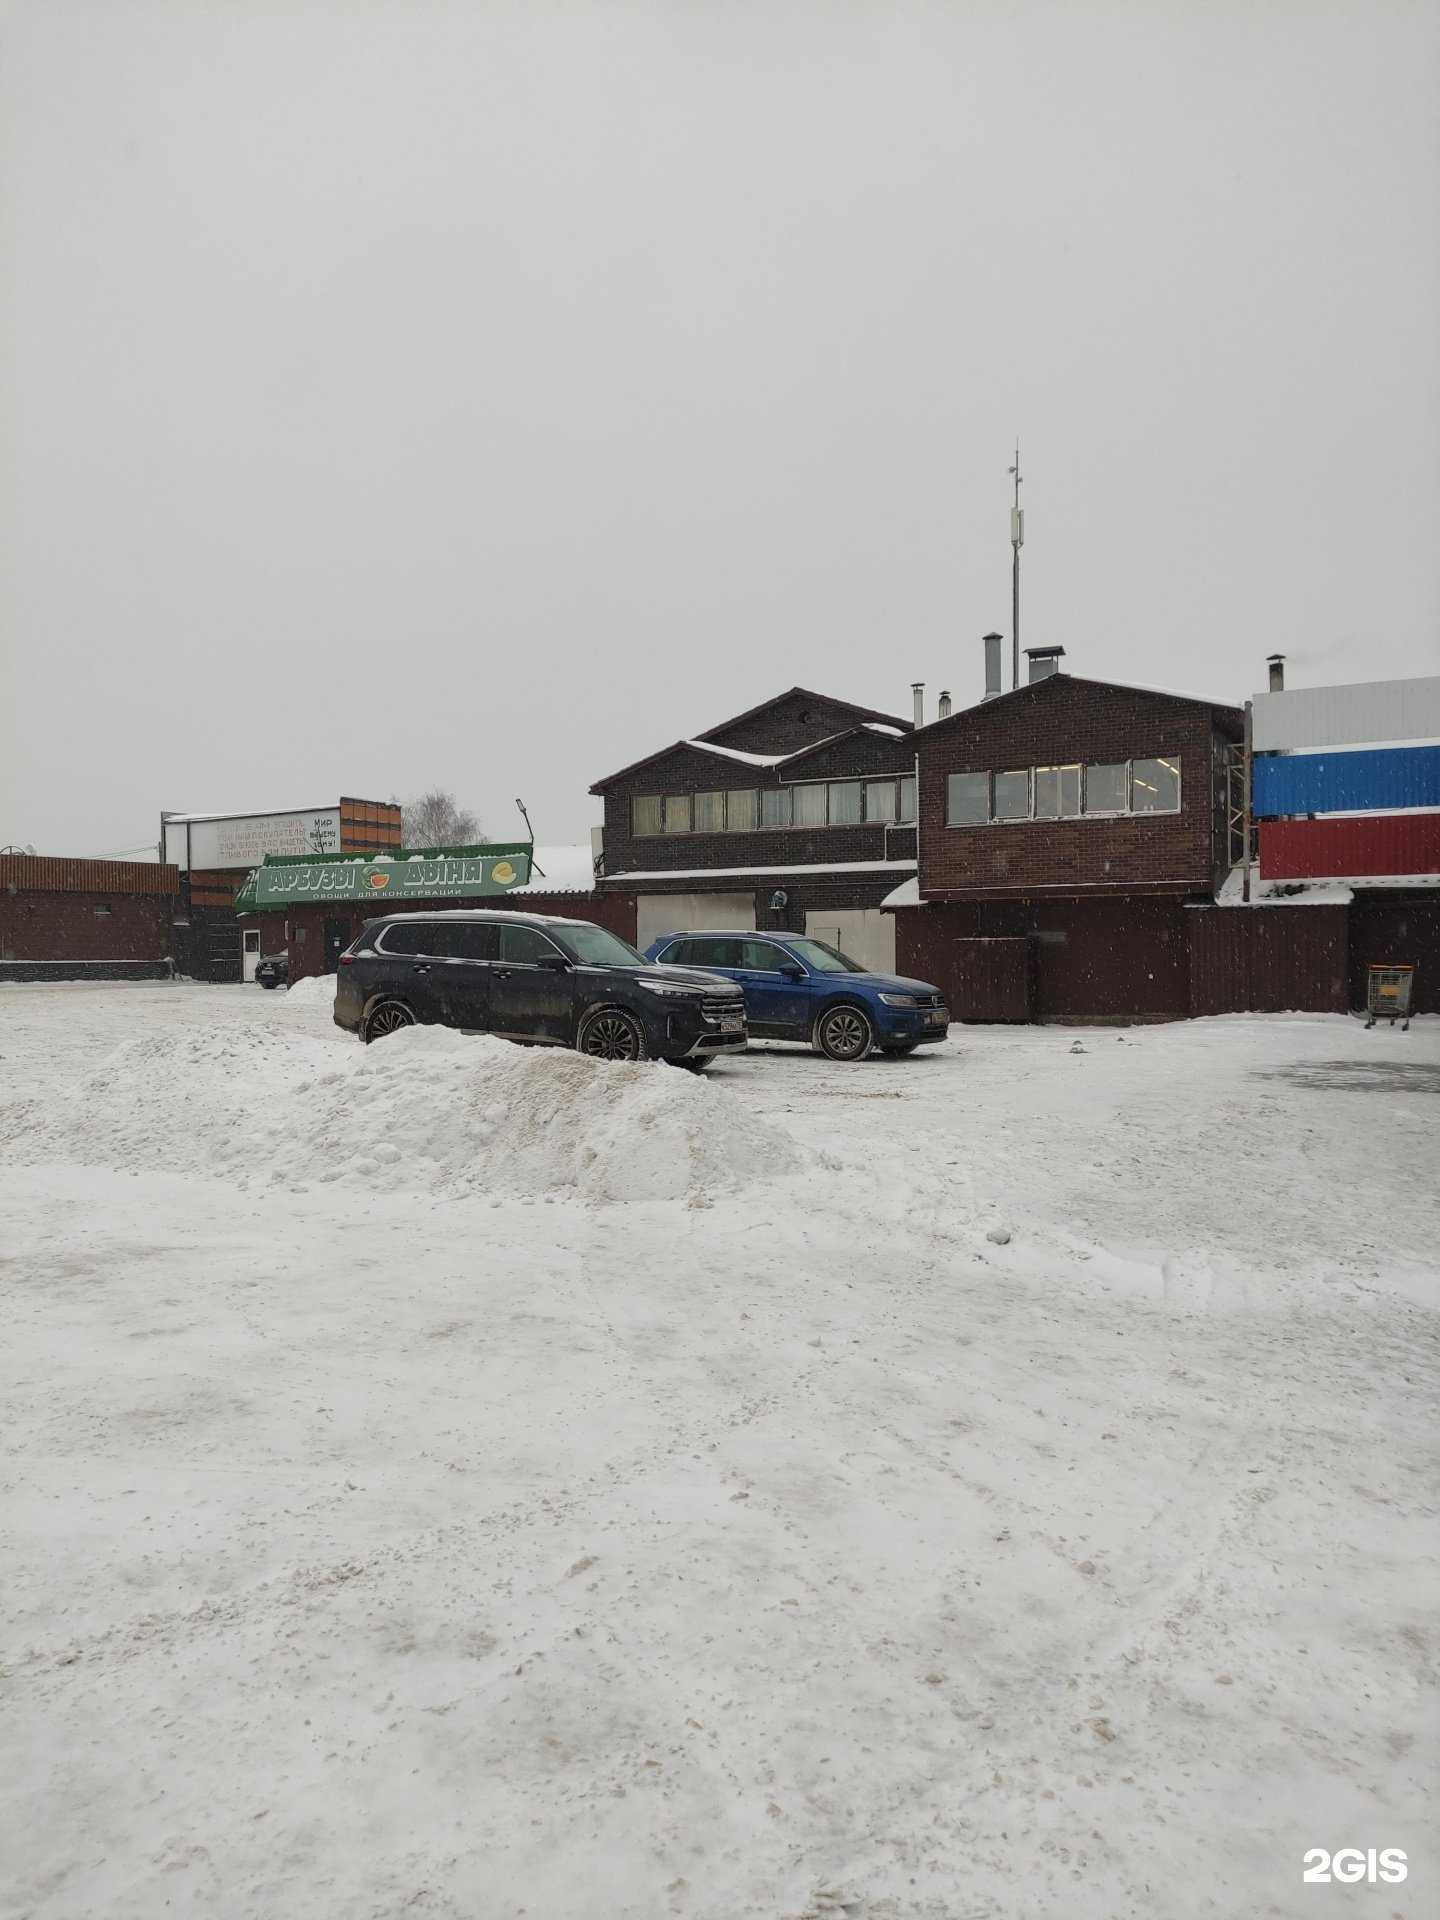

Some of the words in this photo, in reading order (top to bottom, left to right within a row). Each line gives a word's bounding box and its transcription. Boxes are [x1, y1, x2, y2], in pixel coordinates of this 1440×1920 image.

[268, 867, 356, 892] АРБУЗЫ
[403, 860, 483, 886] ДЫНЯ
[312, 891, 350, 900] ОВОЩИ
[358, 890, 379, 899] ДЛЯ
[382, 888, 463, 898] КОНСЕРВАЦИИ
